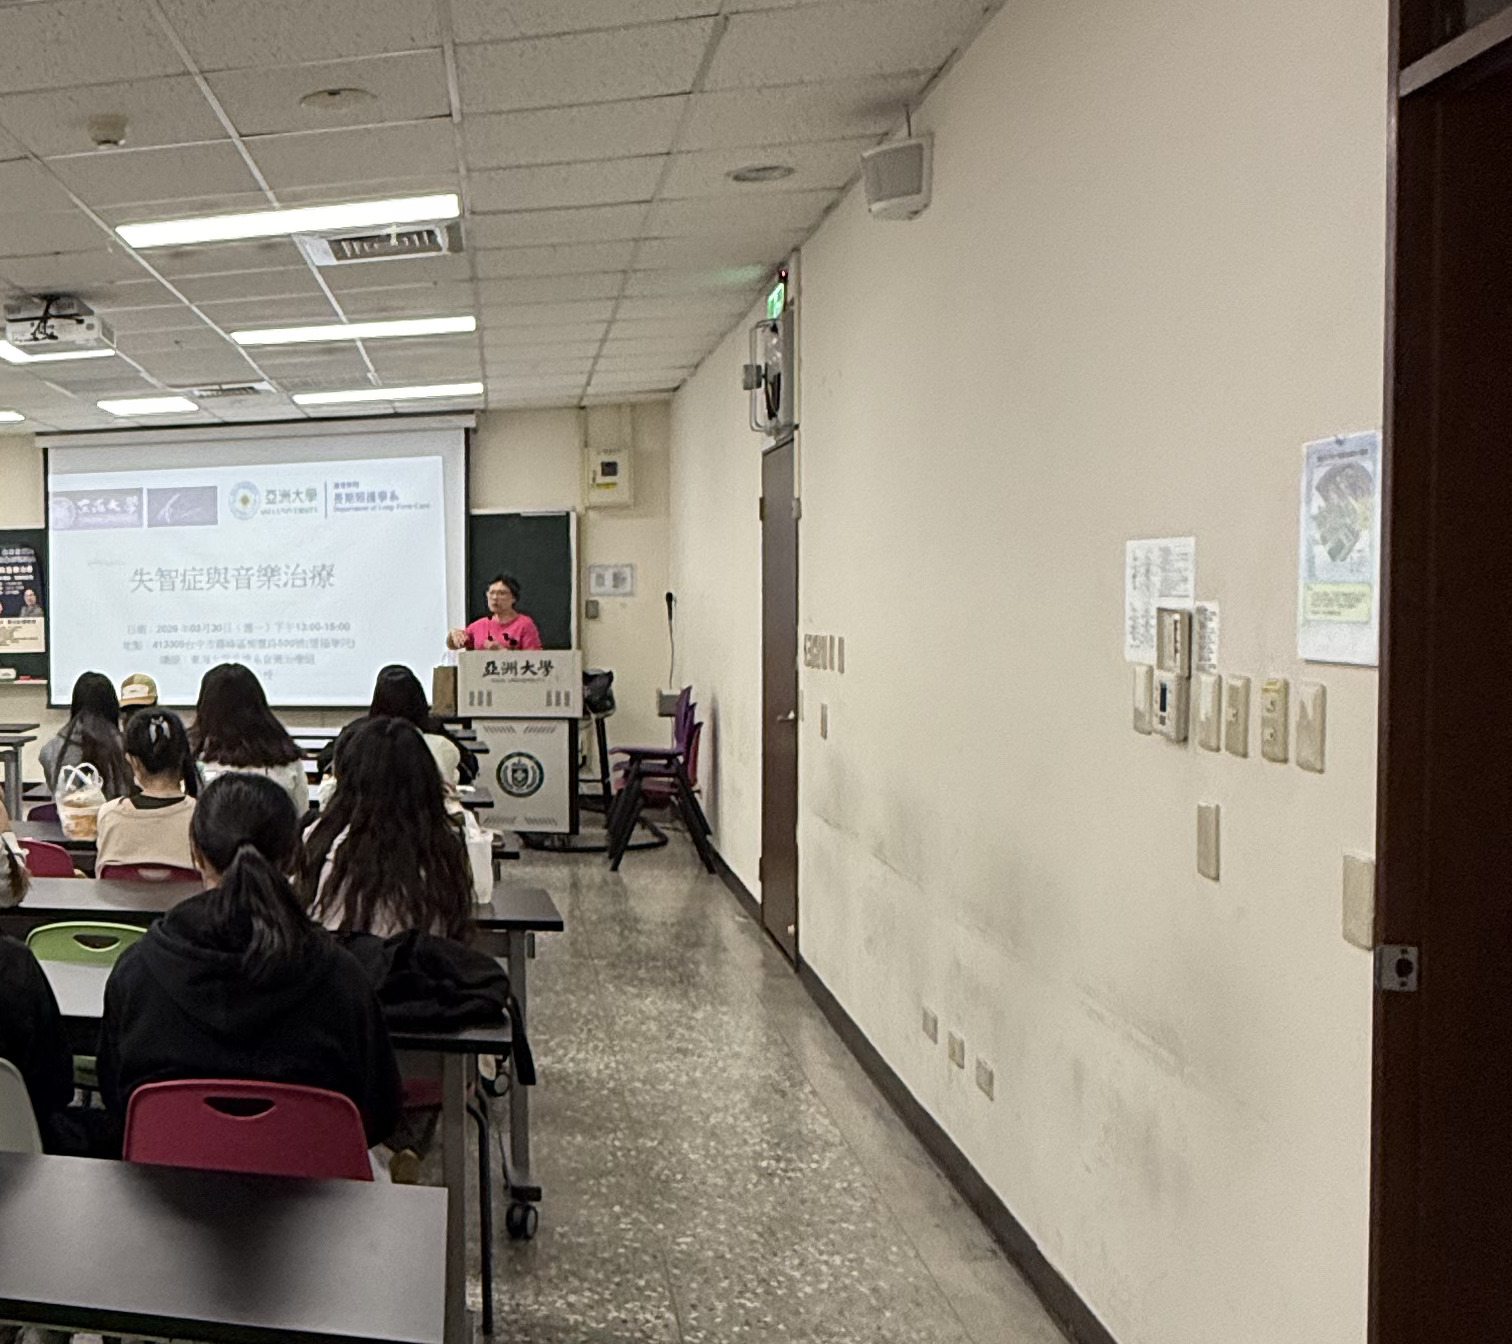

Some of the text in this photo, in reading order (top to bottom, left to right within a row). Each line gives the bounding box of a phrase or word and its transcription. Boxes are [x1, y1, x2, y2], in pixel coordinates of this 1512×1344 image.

[129, 562, 335, 593] 失智症與音樂治療
[482, 659, 554, 678] 亞洲大學
